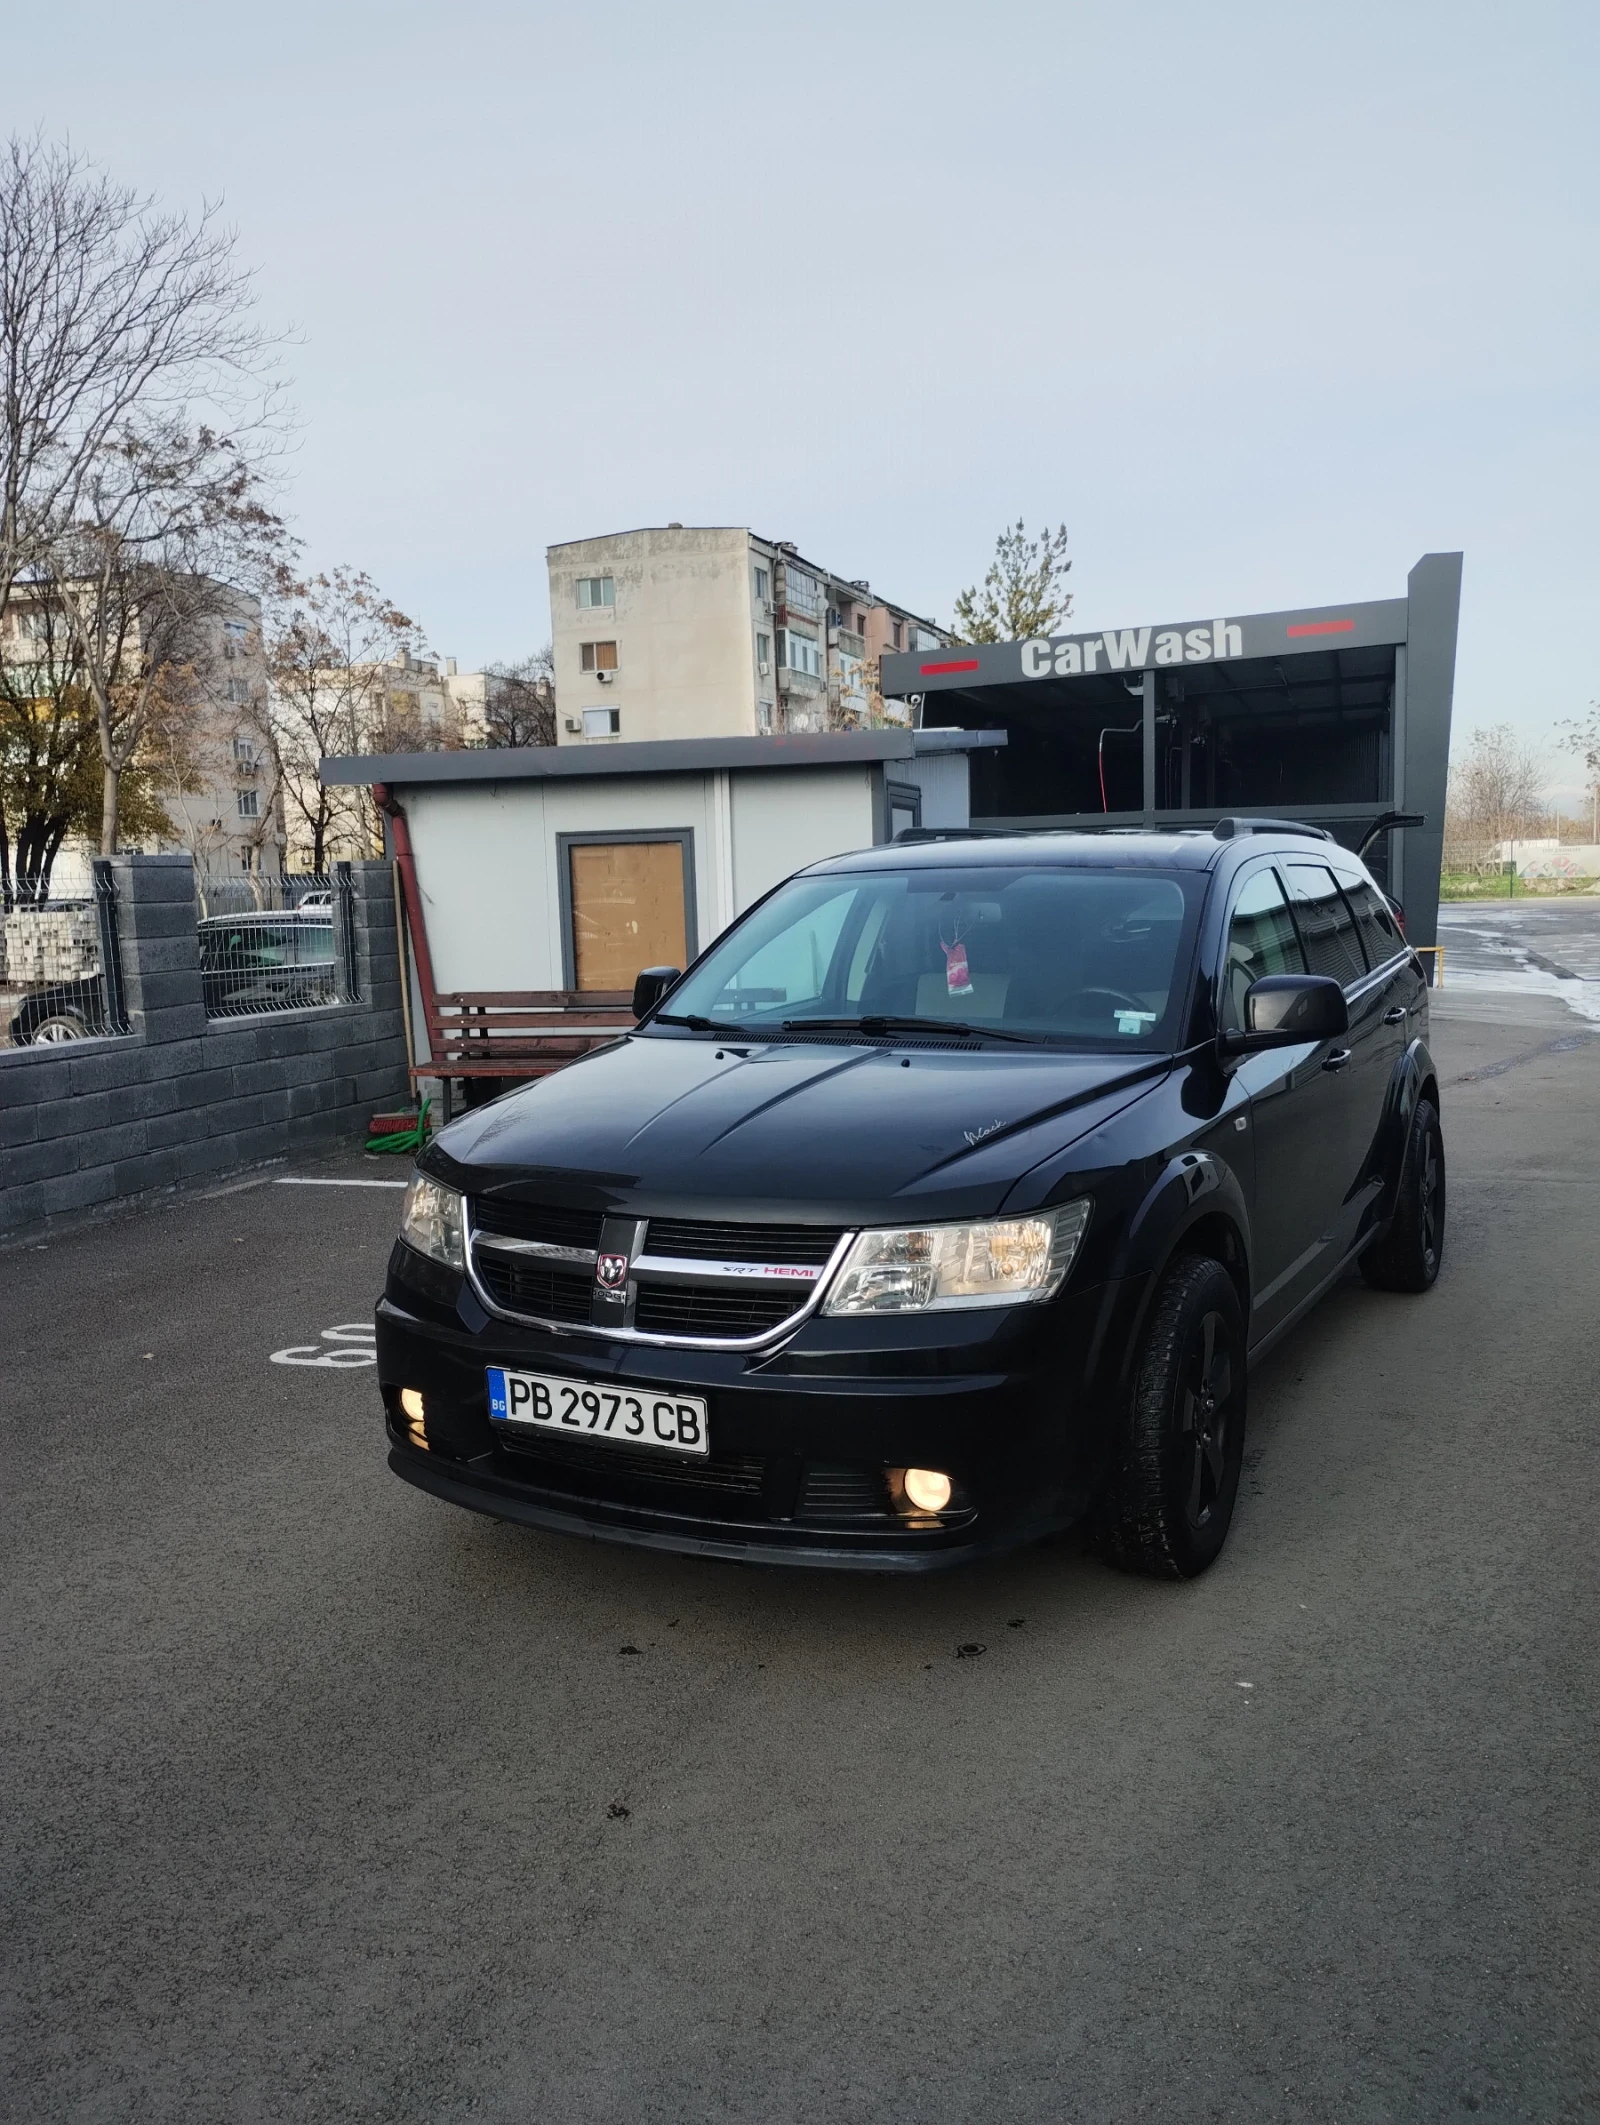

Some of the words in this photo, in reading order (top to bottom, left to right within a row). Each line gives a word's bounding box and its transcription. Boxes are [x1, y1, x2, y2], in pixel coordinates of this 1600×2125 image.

[1021, 619, 1242, 678] CarWash
[720, 1266, 758, 1274] SRT
[764, 1267, 814, 1277] HEMI
[491, 1398, 506, 1411] BG
[508, 1377, 553, 1420] PB
[560, 1387, 644, 1435] 2973
[653, 1401, 700, 1445] CB
